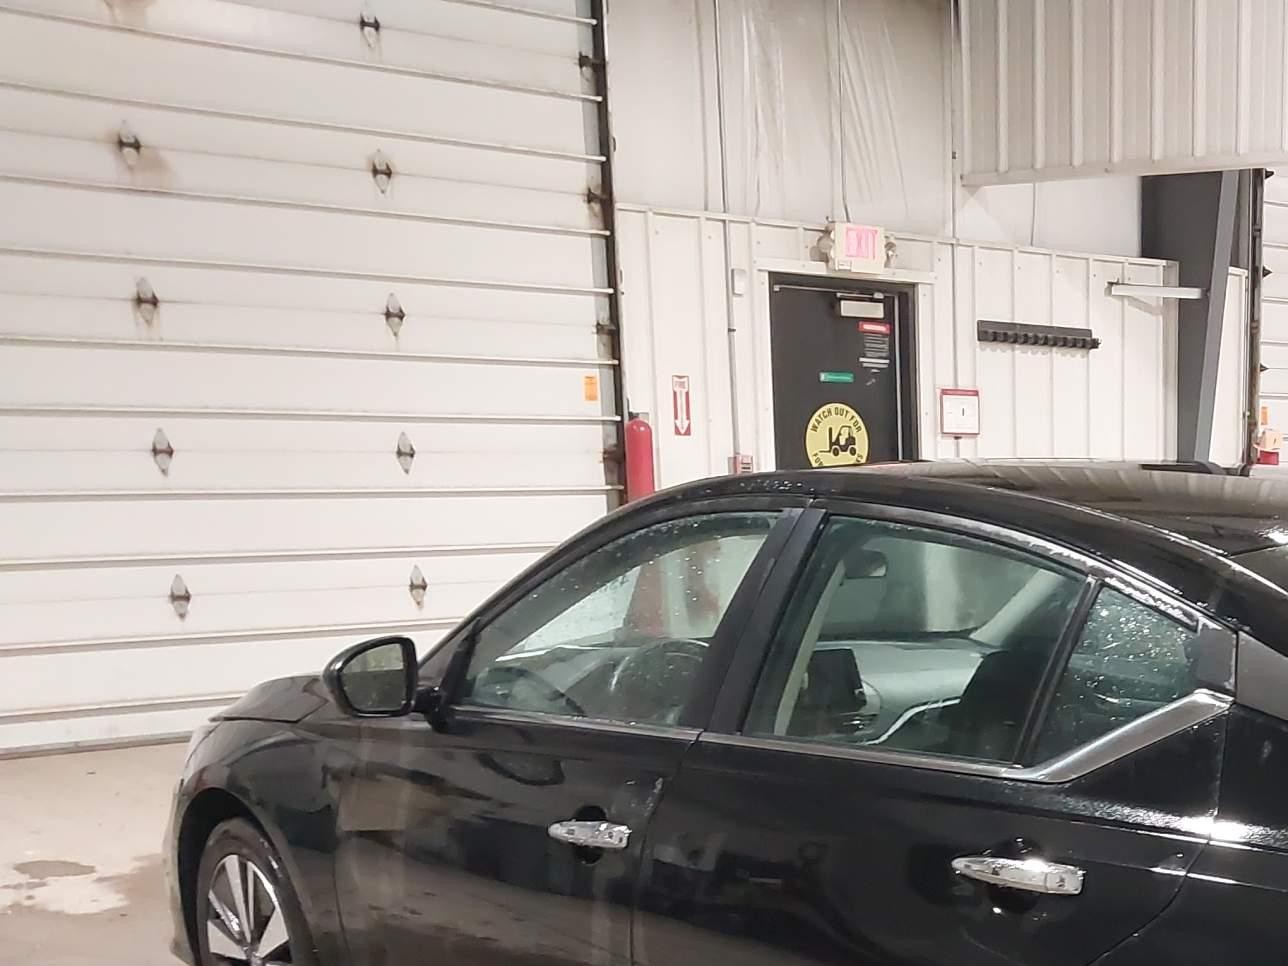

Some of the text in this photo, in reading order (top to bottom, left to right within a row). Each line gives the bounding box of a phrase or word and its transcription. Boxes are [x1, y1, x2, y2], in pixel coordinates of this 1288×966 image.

[845, 227, 878, 260] EXIT
[811, 406, 862, 433] WATCH OUT FOR
